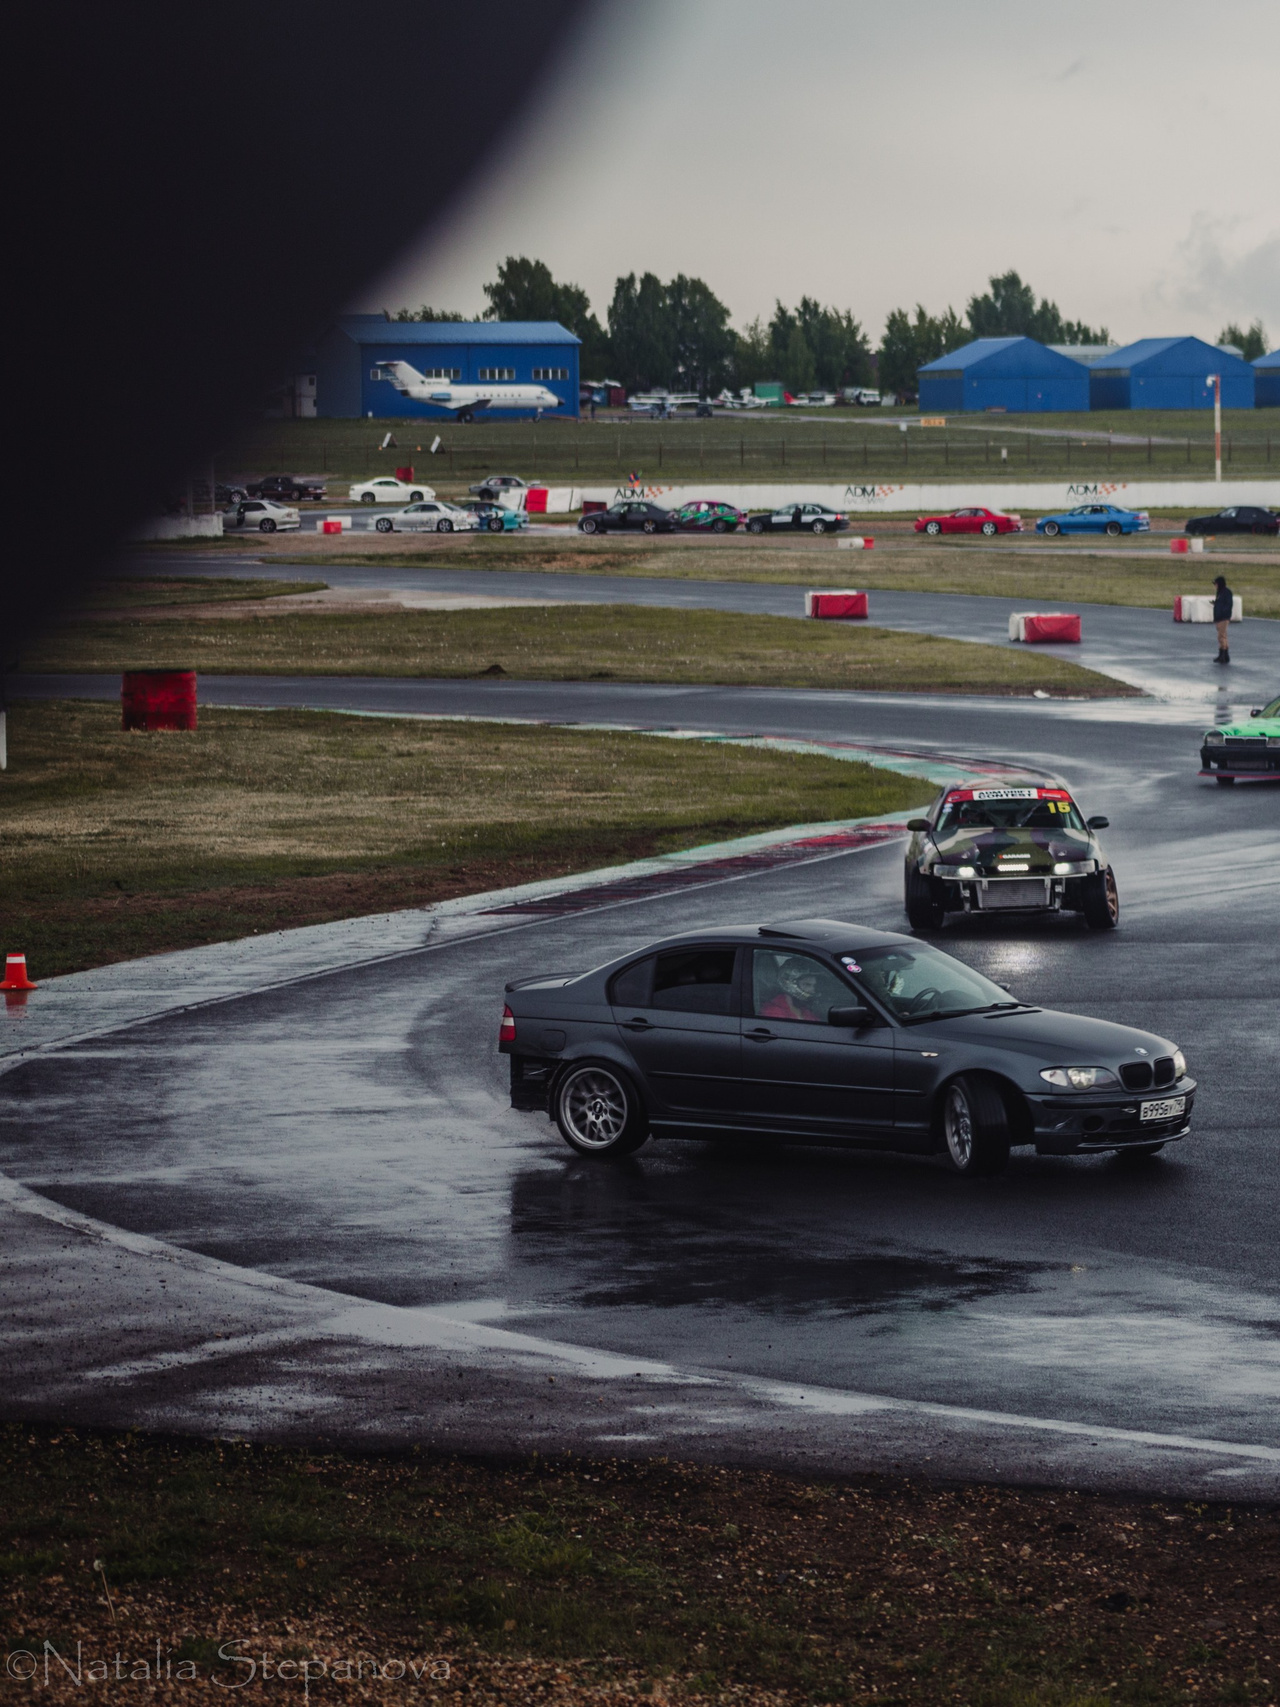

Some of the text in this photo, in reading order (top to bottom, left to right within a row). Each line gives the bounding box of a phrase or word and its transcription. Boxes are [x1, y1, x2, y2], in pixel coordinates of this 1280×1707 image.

[615, 488, 645, 498] ADM
[845, 486, 875, 497] ADM
[1067, 484, 1098, 495] ADM
[1047, 802, 1071, 814] 15
